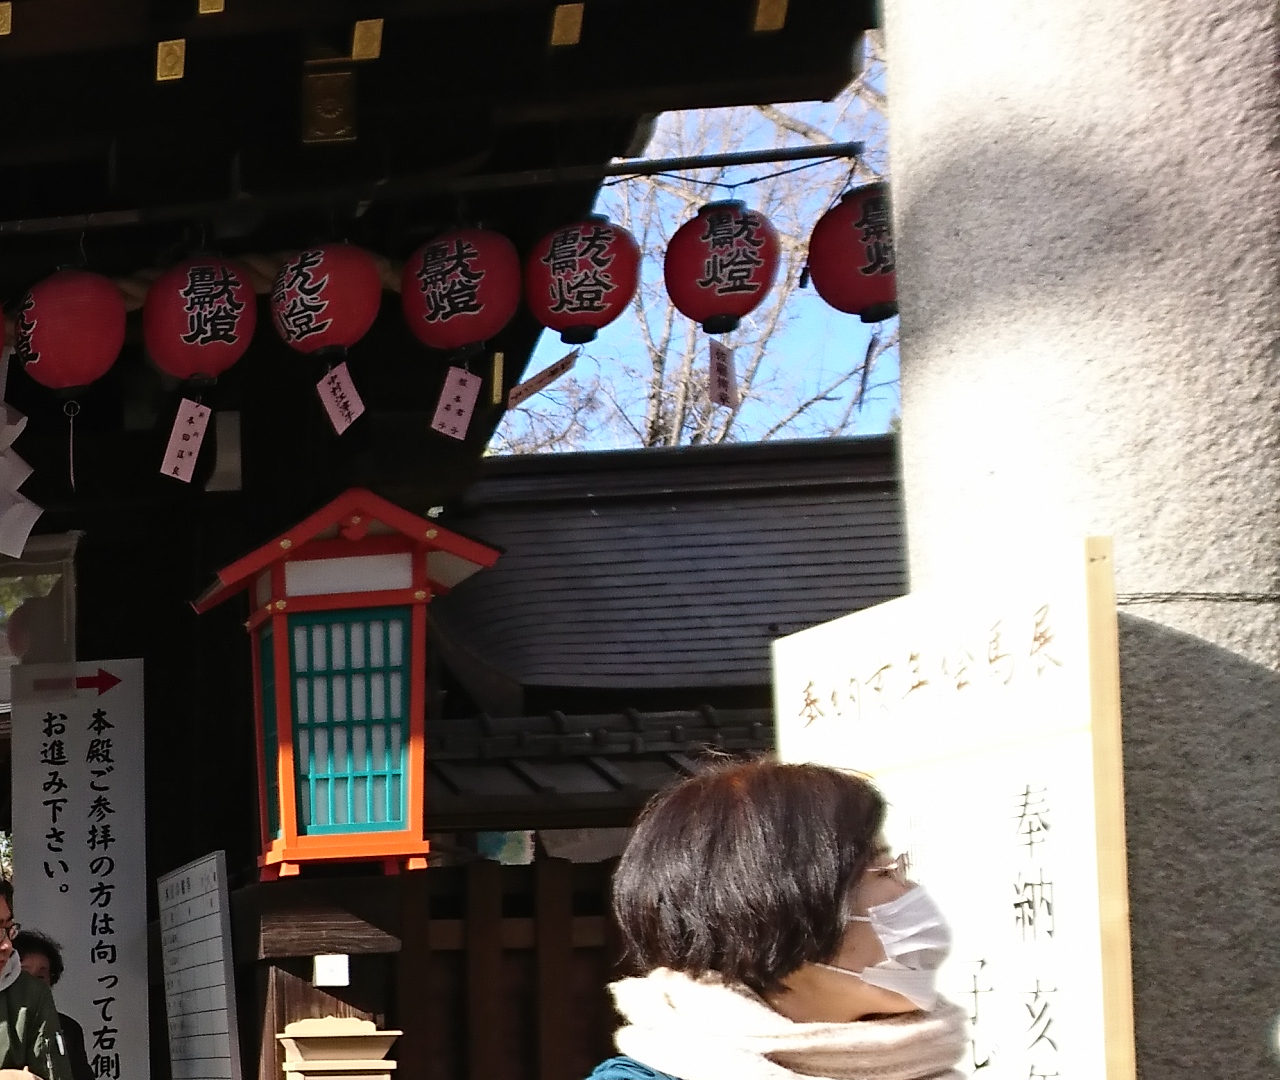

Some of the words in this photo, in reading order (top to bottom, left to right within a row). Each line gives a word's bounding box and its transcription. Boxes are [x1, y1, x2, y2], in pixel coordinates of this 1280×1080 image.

[39, 712, 70, 894] お進み下さい。
